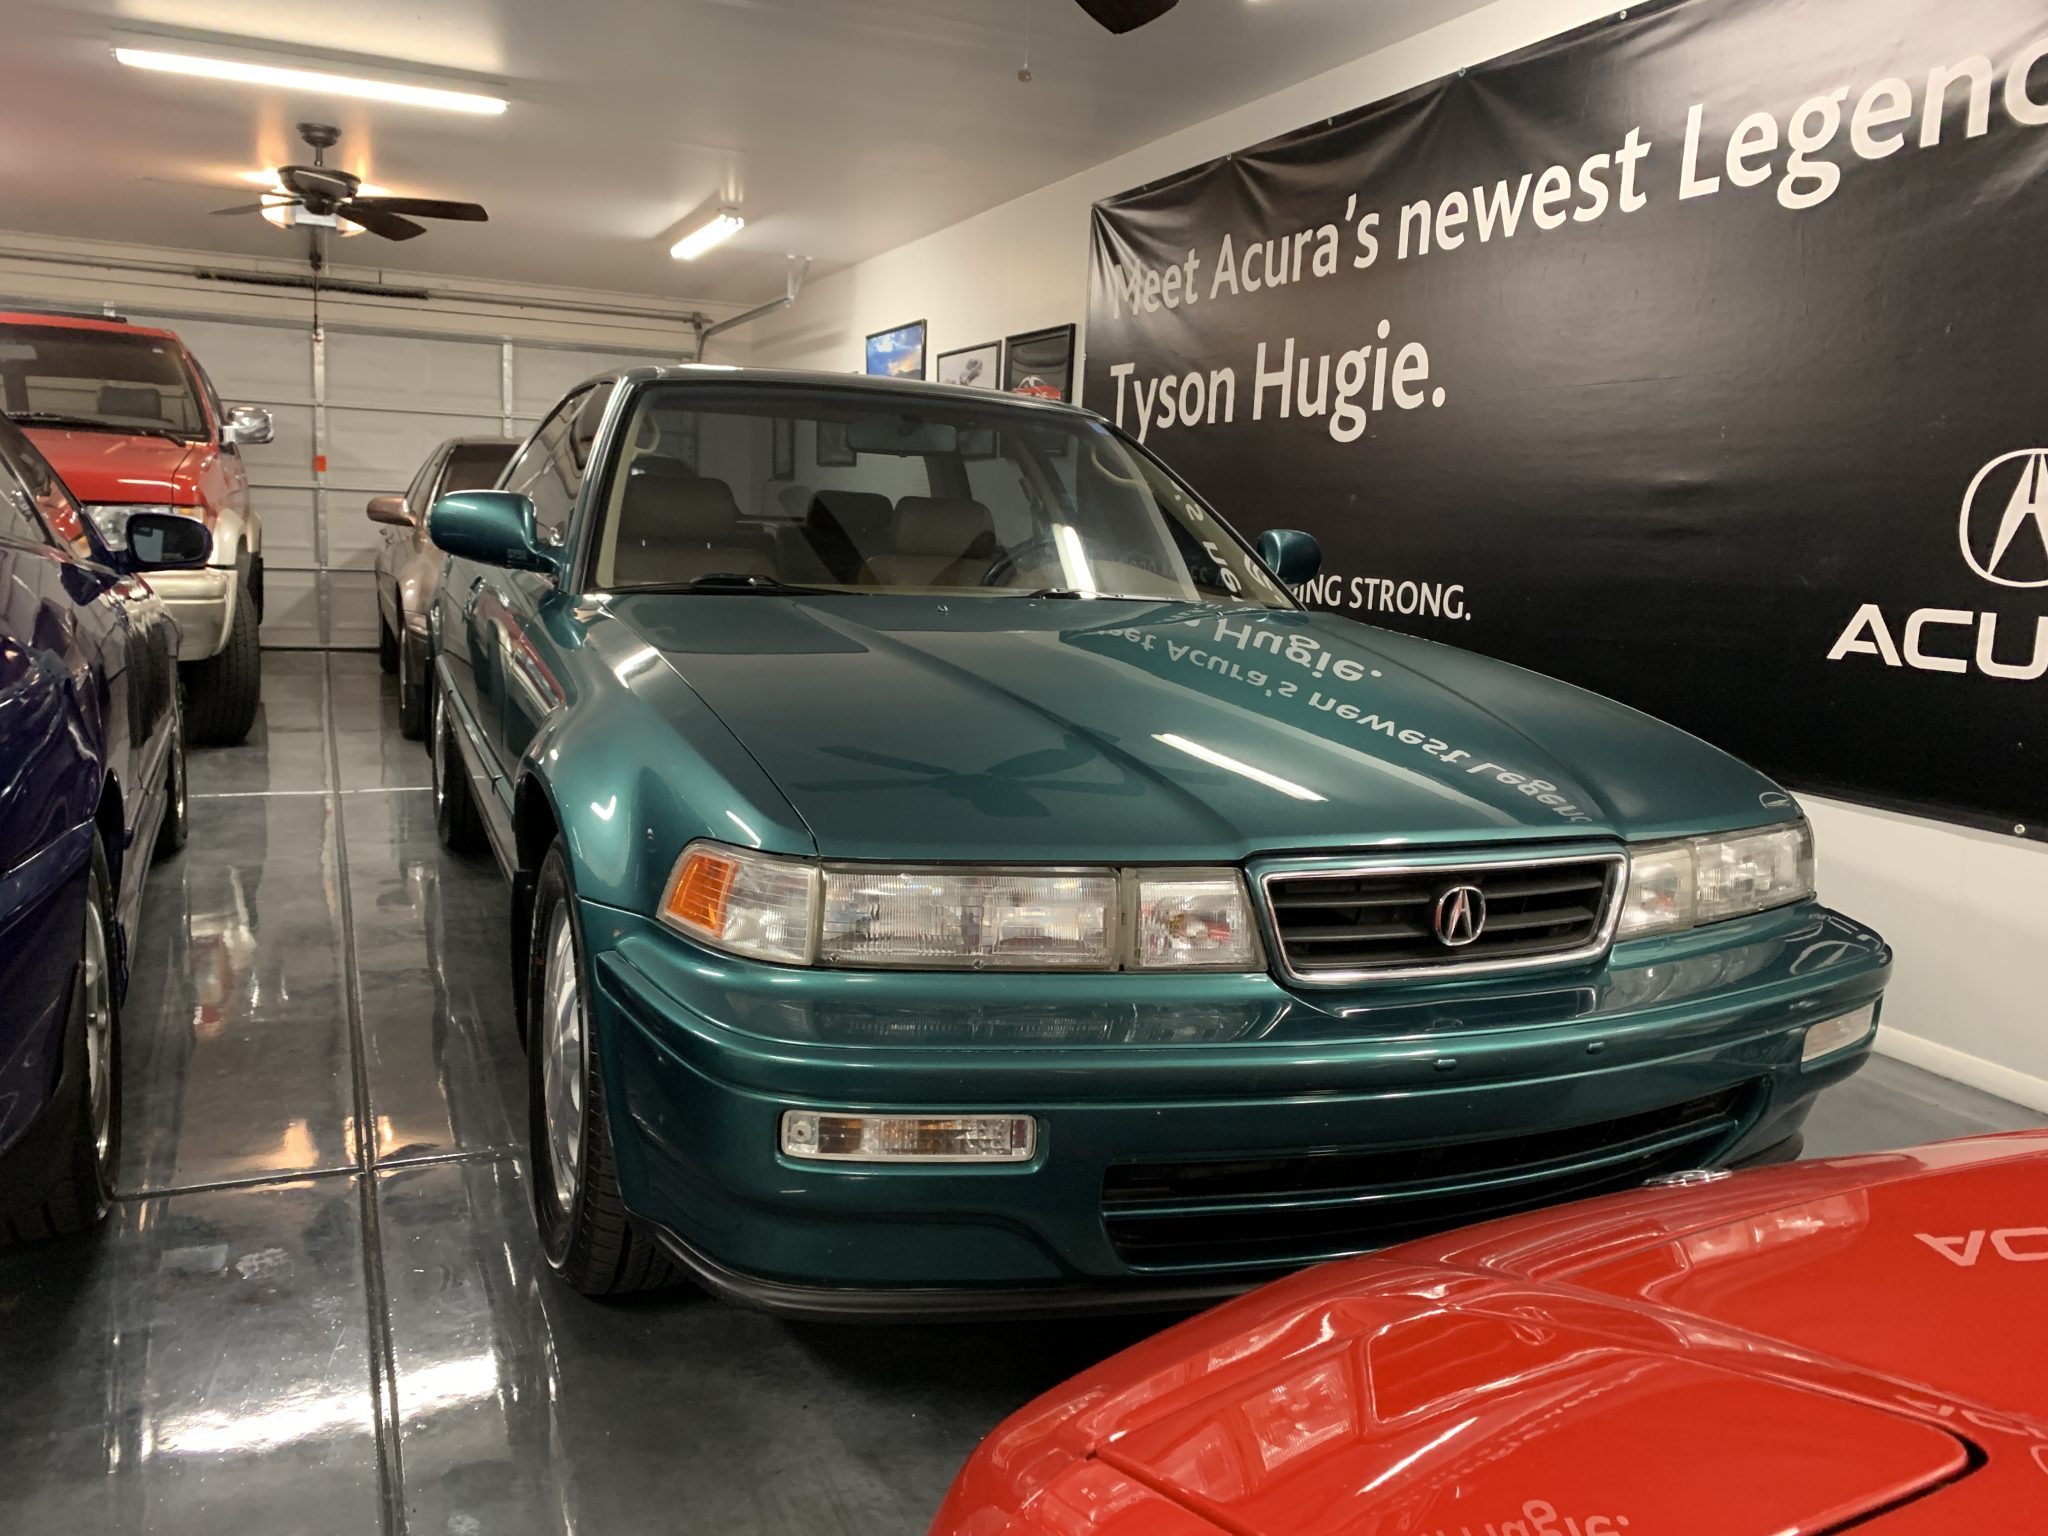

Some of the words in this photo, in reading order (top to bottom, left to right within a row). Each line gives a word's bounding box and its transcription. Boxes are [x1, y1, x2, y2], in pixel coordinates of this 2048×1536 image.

[1111, 247, 1200, 320] Meet
[1209, 193, 1380, 299] Acura's
[1397, 126, 1652, 260] newest
[1110, 361, 1235, 444] Tyson
[1252, 318, 1446, 443] Hugie.
[1293, 574, 1342, 607] ING
[1348, 576, 1472, 622] STRONG.
